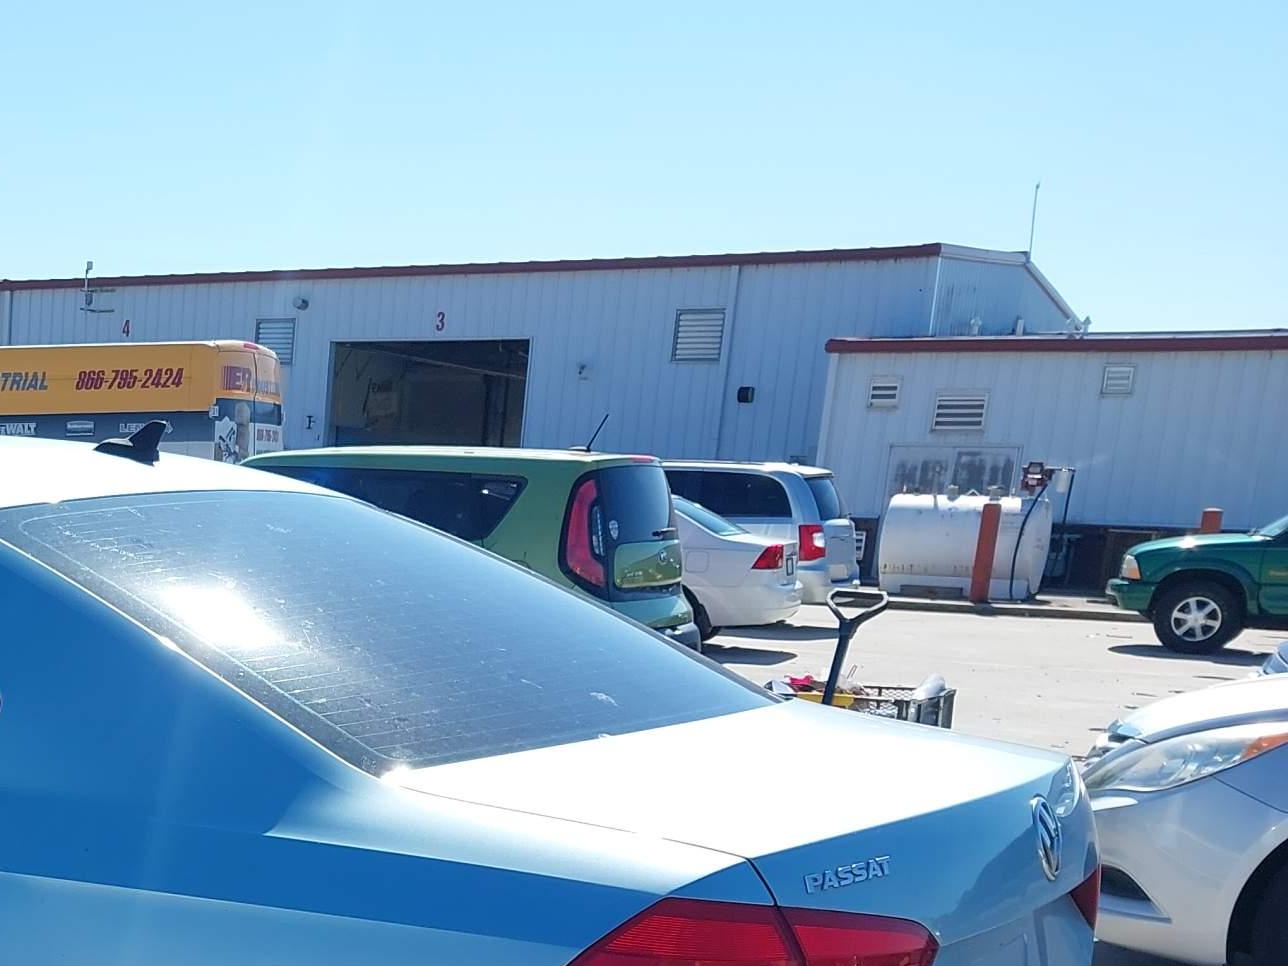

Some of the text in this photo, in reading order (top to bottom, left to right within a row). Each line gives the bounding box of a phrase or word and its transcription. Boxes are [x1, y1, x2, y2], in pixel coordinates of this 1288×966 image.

[121, 319, 132, 338] 4
[435, 311, 446, 332] 3
[75, 368, 184, 391] 866-795-2424
[803, 854, 891, 895] PASSAT
